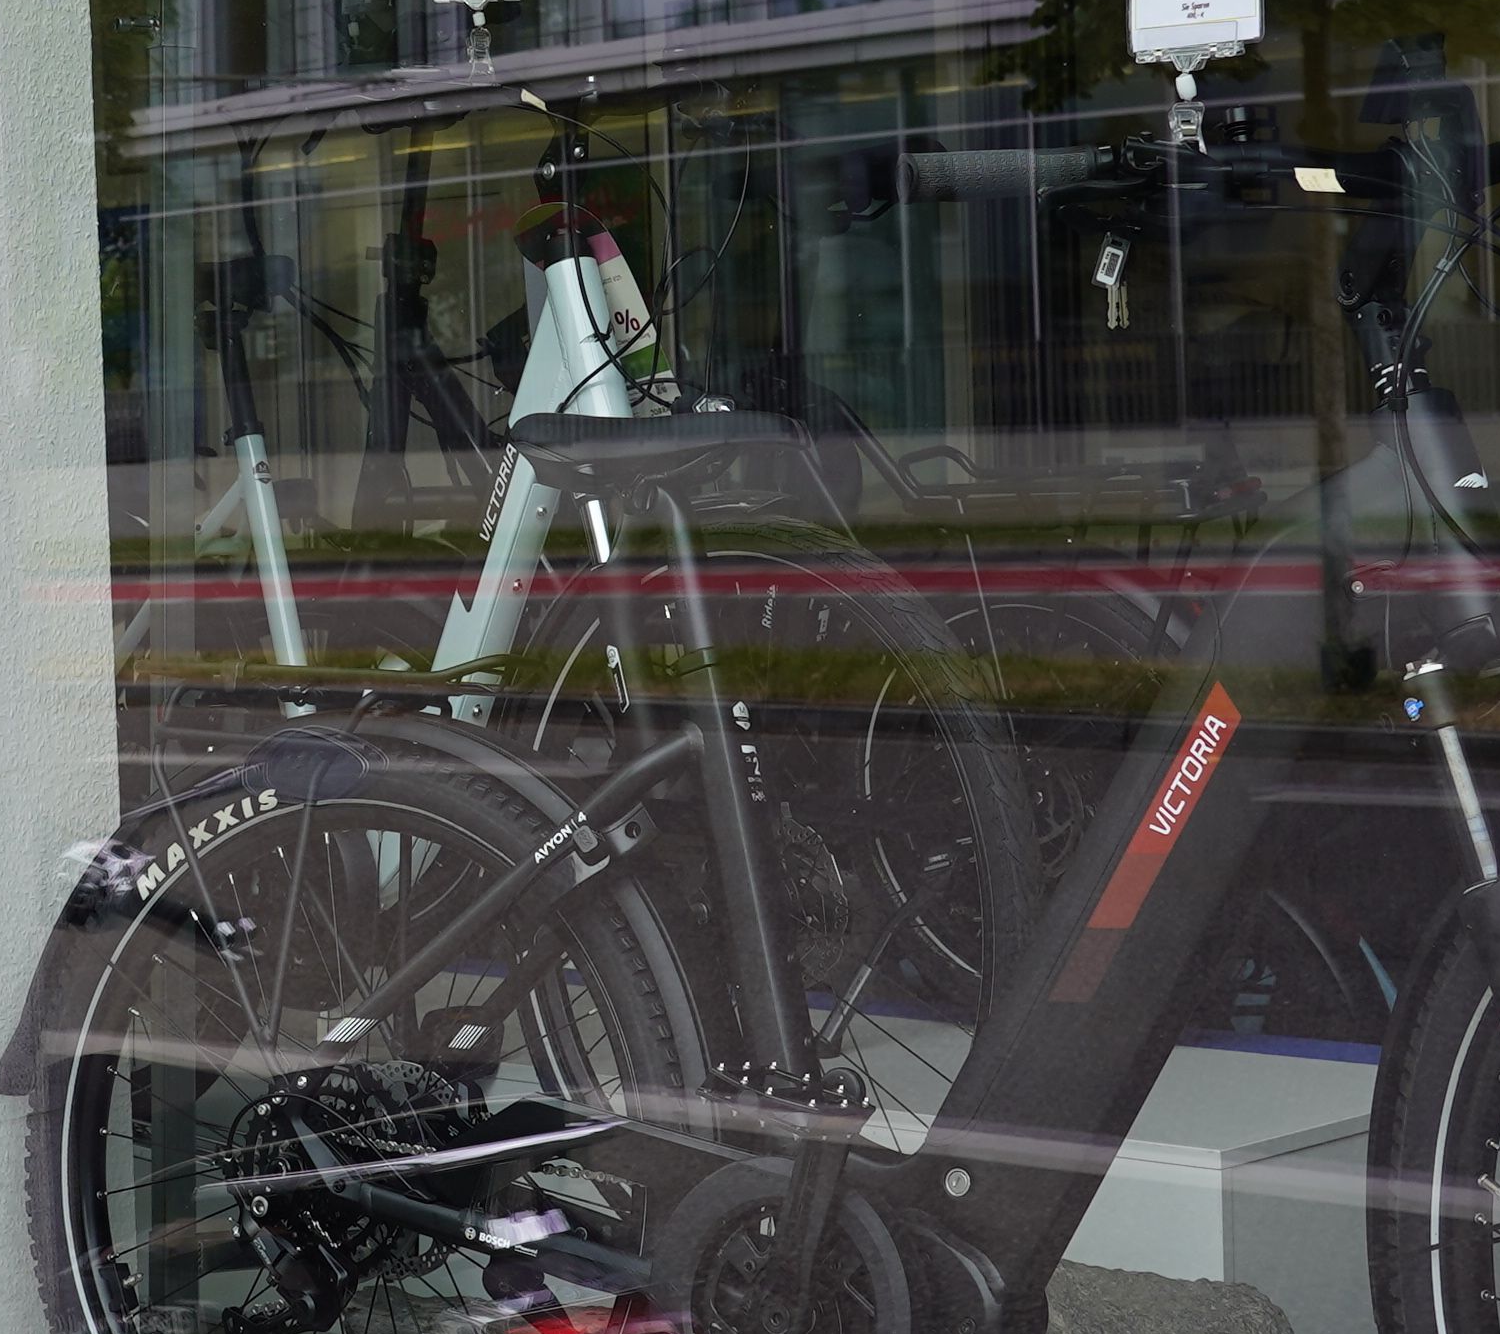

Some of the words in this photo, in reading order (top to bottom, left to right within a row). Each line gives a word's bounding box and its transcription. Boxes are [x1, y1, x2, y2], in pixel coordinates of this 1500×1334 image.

[479, 442, 517, 543] VICTORIA
[1149, 713, 1228, 836] VICTORIA
[137, 787, 280, 901] MAXXIS
[534, 825, 573, 865] AVYON
[478, 1232, 511, 1249] BOSCH
